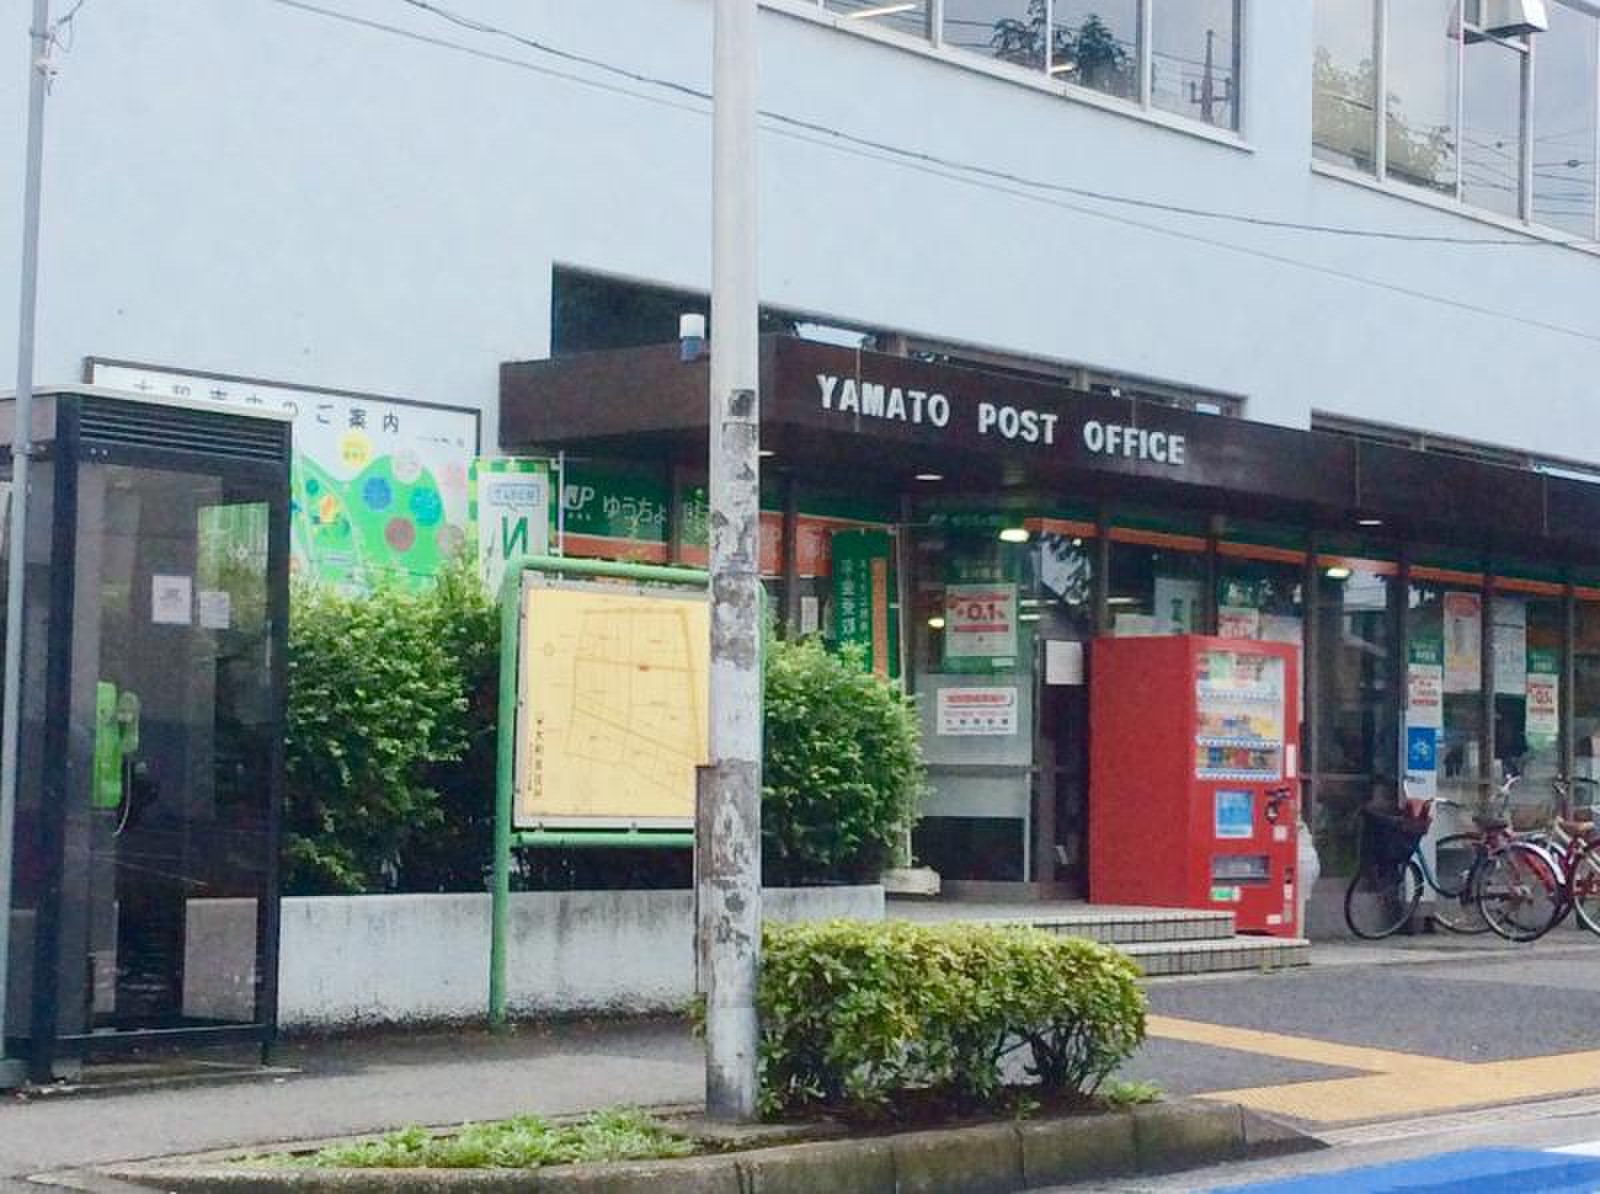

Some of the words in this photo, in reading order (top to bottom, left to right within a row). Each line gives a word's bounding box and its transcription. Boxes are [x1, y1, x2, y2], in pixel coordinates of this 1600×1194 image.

[816, 374, 950, 428] YAMATO
[978, 402, 1058, 445] POST
[1083, 420, 1186, 465] OFFICE
